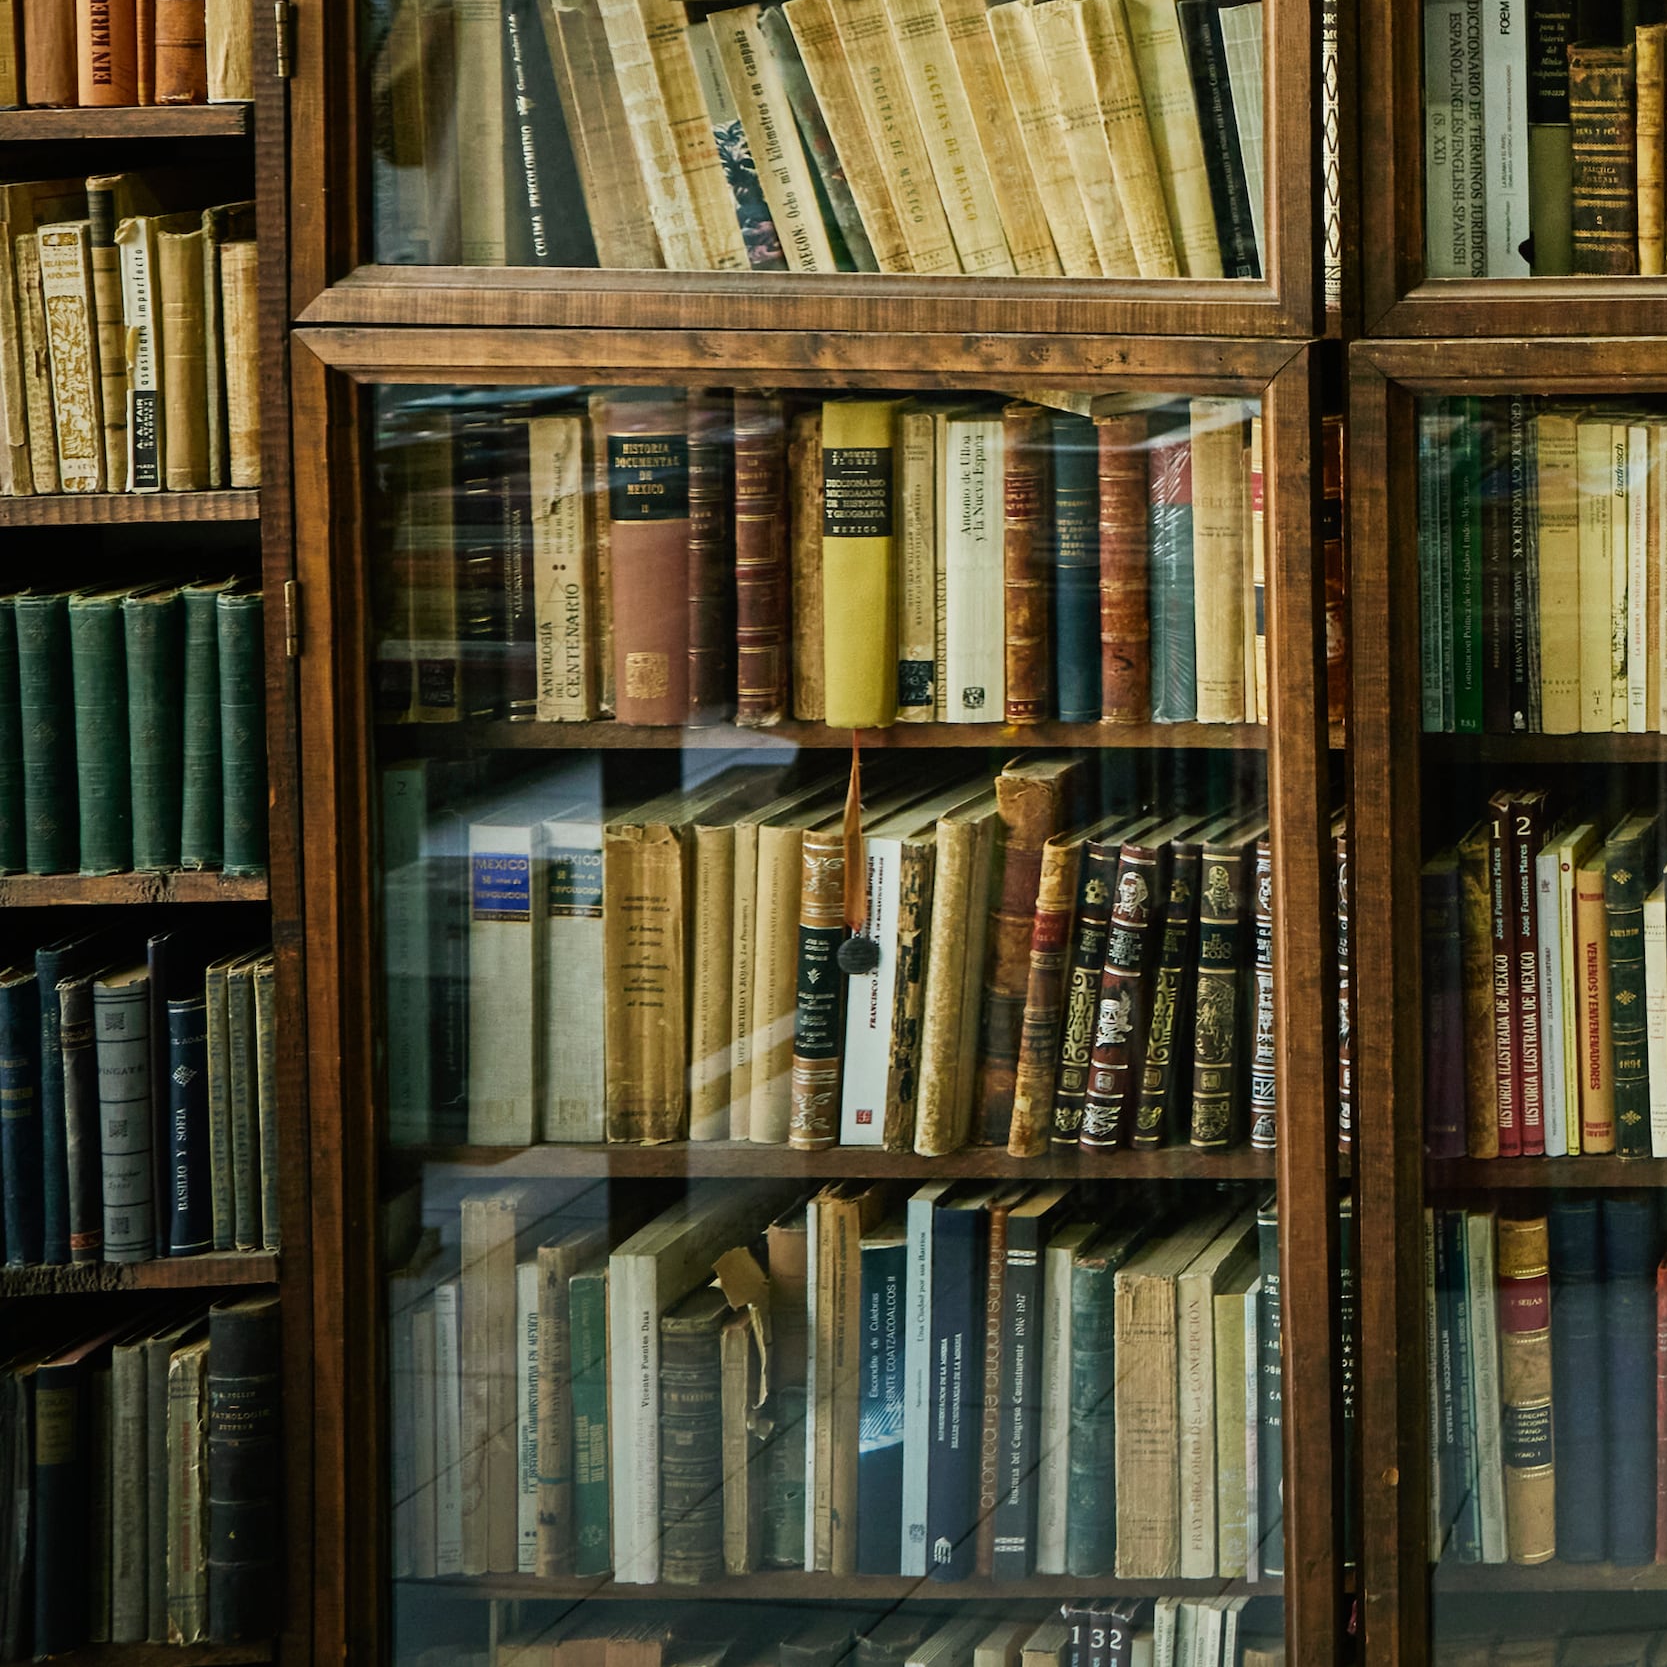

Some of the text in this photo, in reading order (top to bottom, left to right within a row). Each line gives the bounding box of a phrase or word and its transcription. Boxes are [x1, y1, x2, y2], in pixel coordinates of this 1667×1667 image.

[93, 52, 111, 85] EIN
[1448, 12, 1466, 265] ESPAÑOL-INGLÉS/ENGLISH-SPANISH
[1466, 0, 1486, 278] DICCIONARIO DE TÉRMINOS JURÍDICOS
[1521, 952, 1538, 1125] HISTORIA ILUSTRADA DE MEXICO
